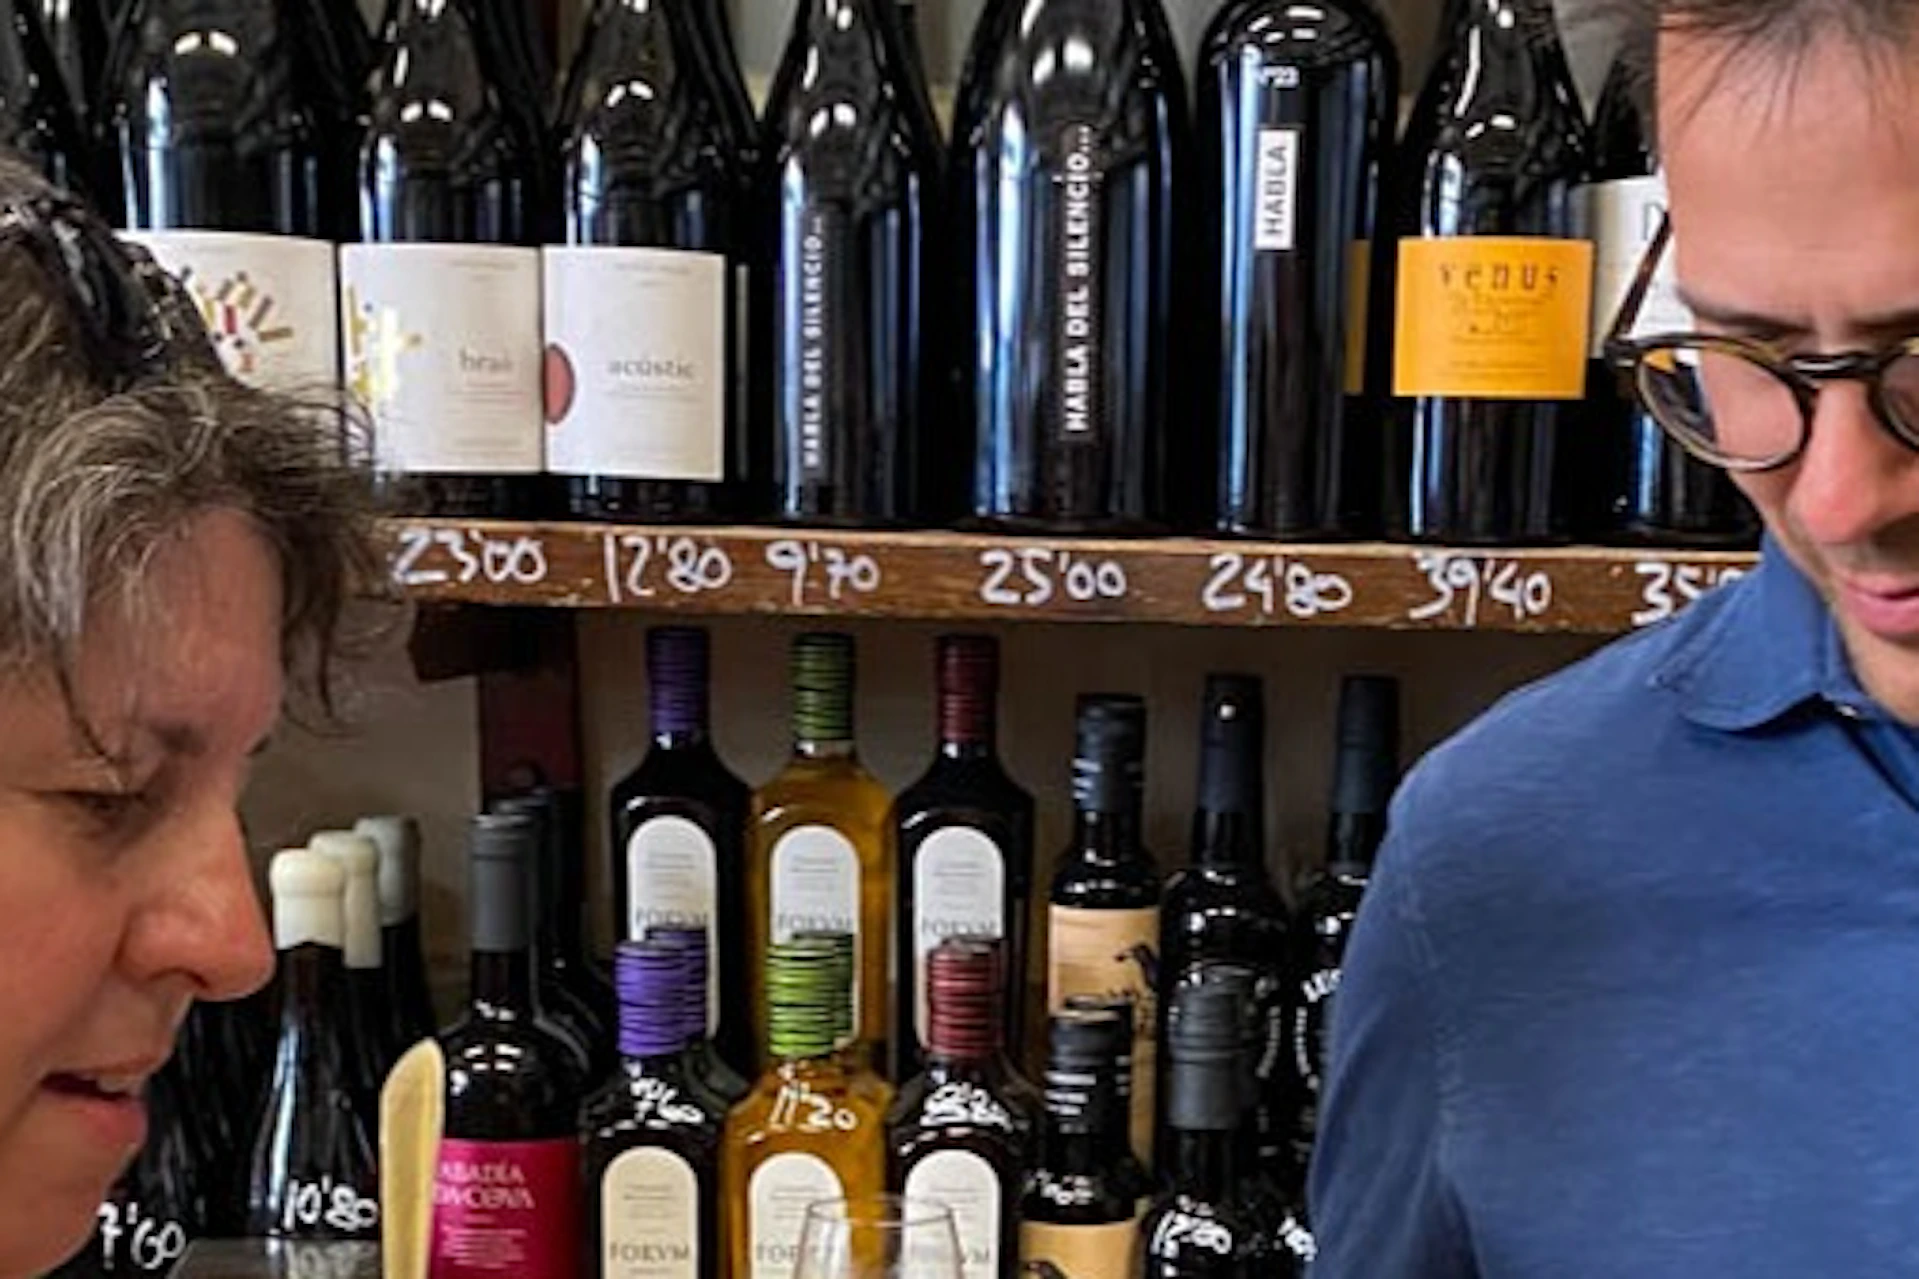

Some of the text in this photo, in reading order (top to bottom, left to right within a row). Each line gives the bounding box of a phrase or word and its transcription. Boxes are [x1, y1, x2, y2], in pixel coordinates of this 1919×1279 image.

[1264, 146, 1288, 235] HABLA
[1065, 285, 1089, 338] DEL
[802, 346, 822, 390] DEL
[1064, 346, 1089, 432] HABLA
[393, 527, 548, 584] 23'00
[603, 531, 733, 603] 12'80
[765, 540, 880, 606] 9'70
[979, 547, 1127, 605] 25'00
[1203, 552, 1353, 617] 24'80
[1408, 549, 1552, 627] 39'40
[97, 1200, 187, 1270] 7'60
[283, 1174, 379, 1232] 10'80
